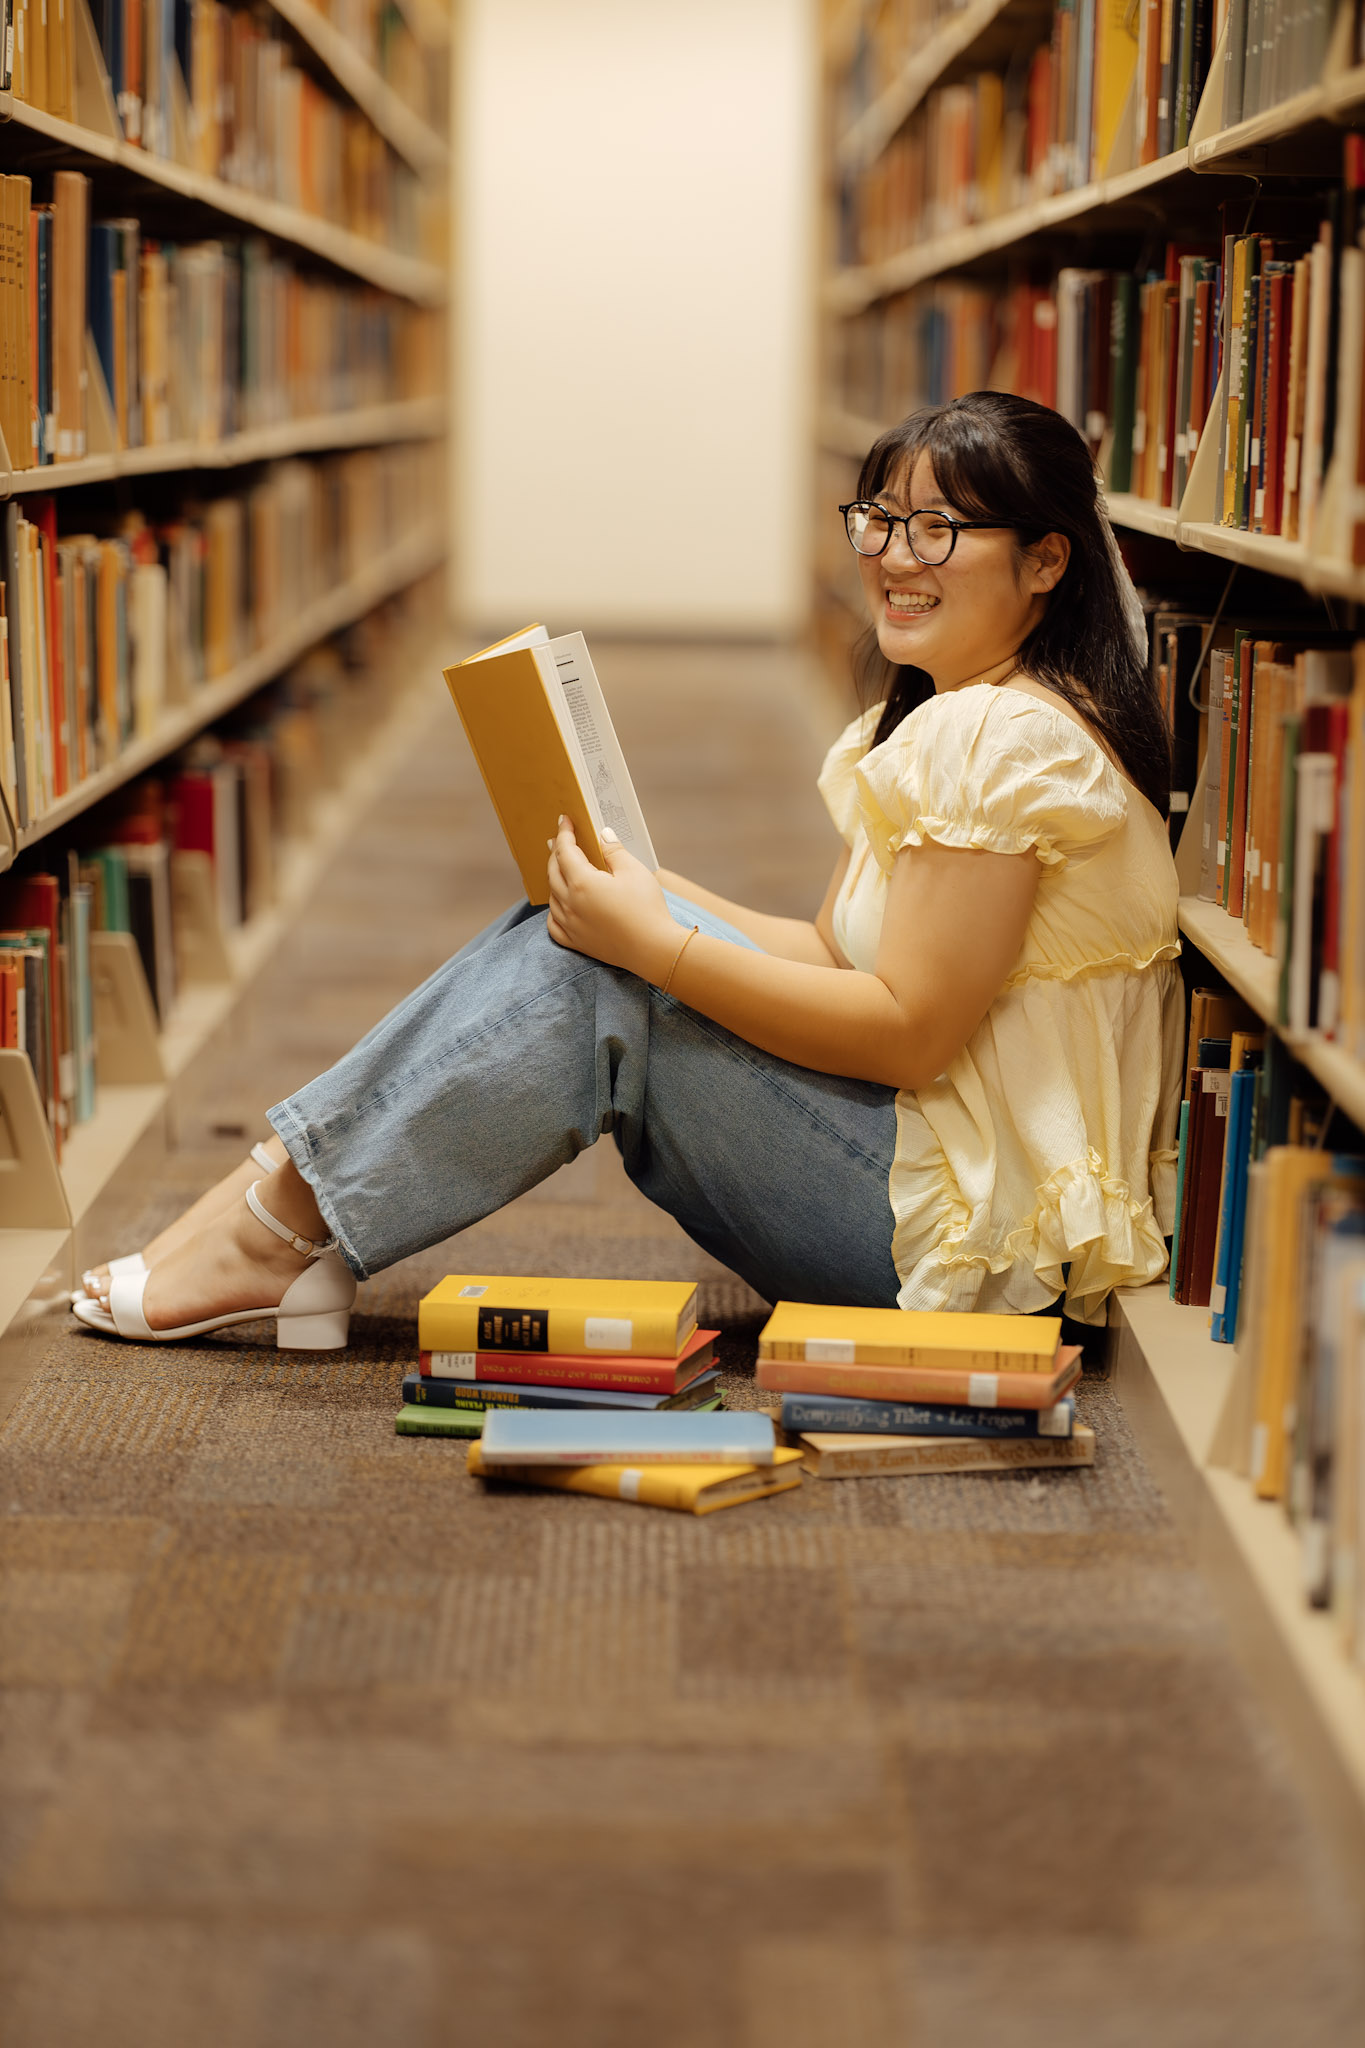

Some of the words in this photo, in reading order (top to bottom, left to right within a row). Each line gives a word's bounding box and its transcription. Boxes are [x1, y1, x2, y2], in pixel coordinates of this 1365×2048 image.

[611, 1374, 651, 1385] COMRADE
[454, 1386, 479, 1399] WOOD
[481, 1390, 520, 1404] FRANCES
[454, 1399, 484, 1411] PEKING
[792, 1404, 890, 1428] Demystifying
[894, 1406, 930, 1425] Tibet
[949, 1410, 974, 1426] Lee
